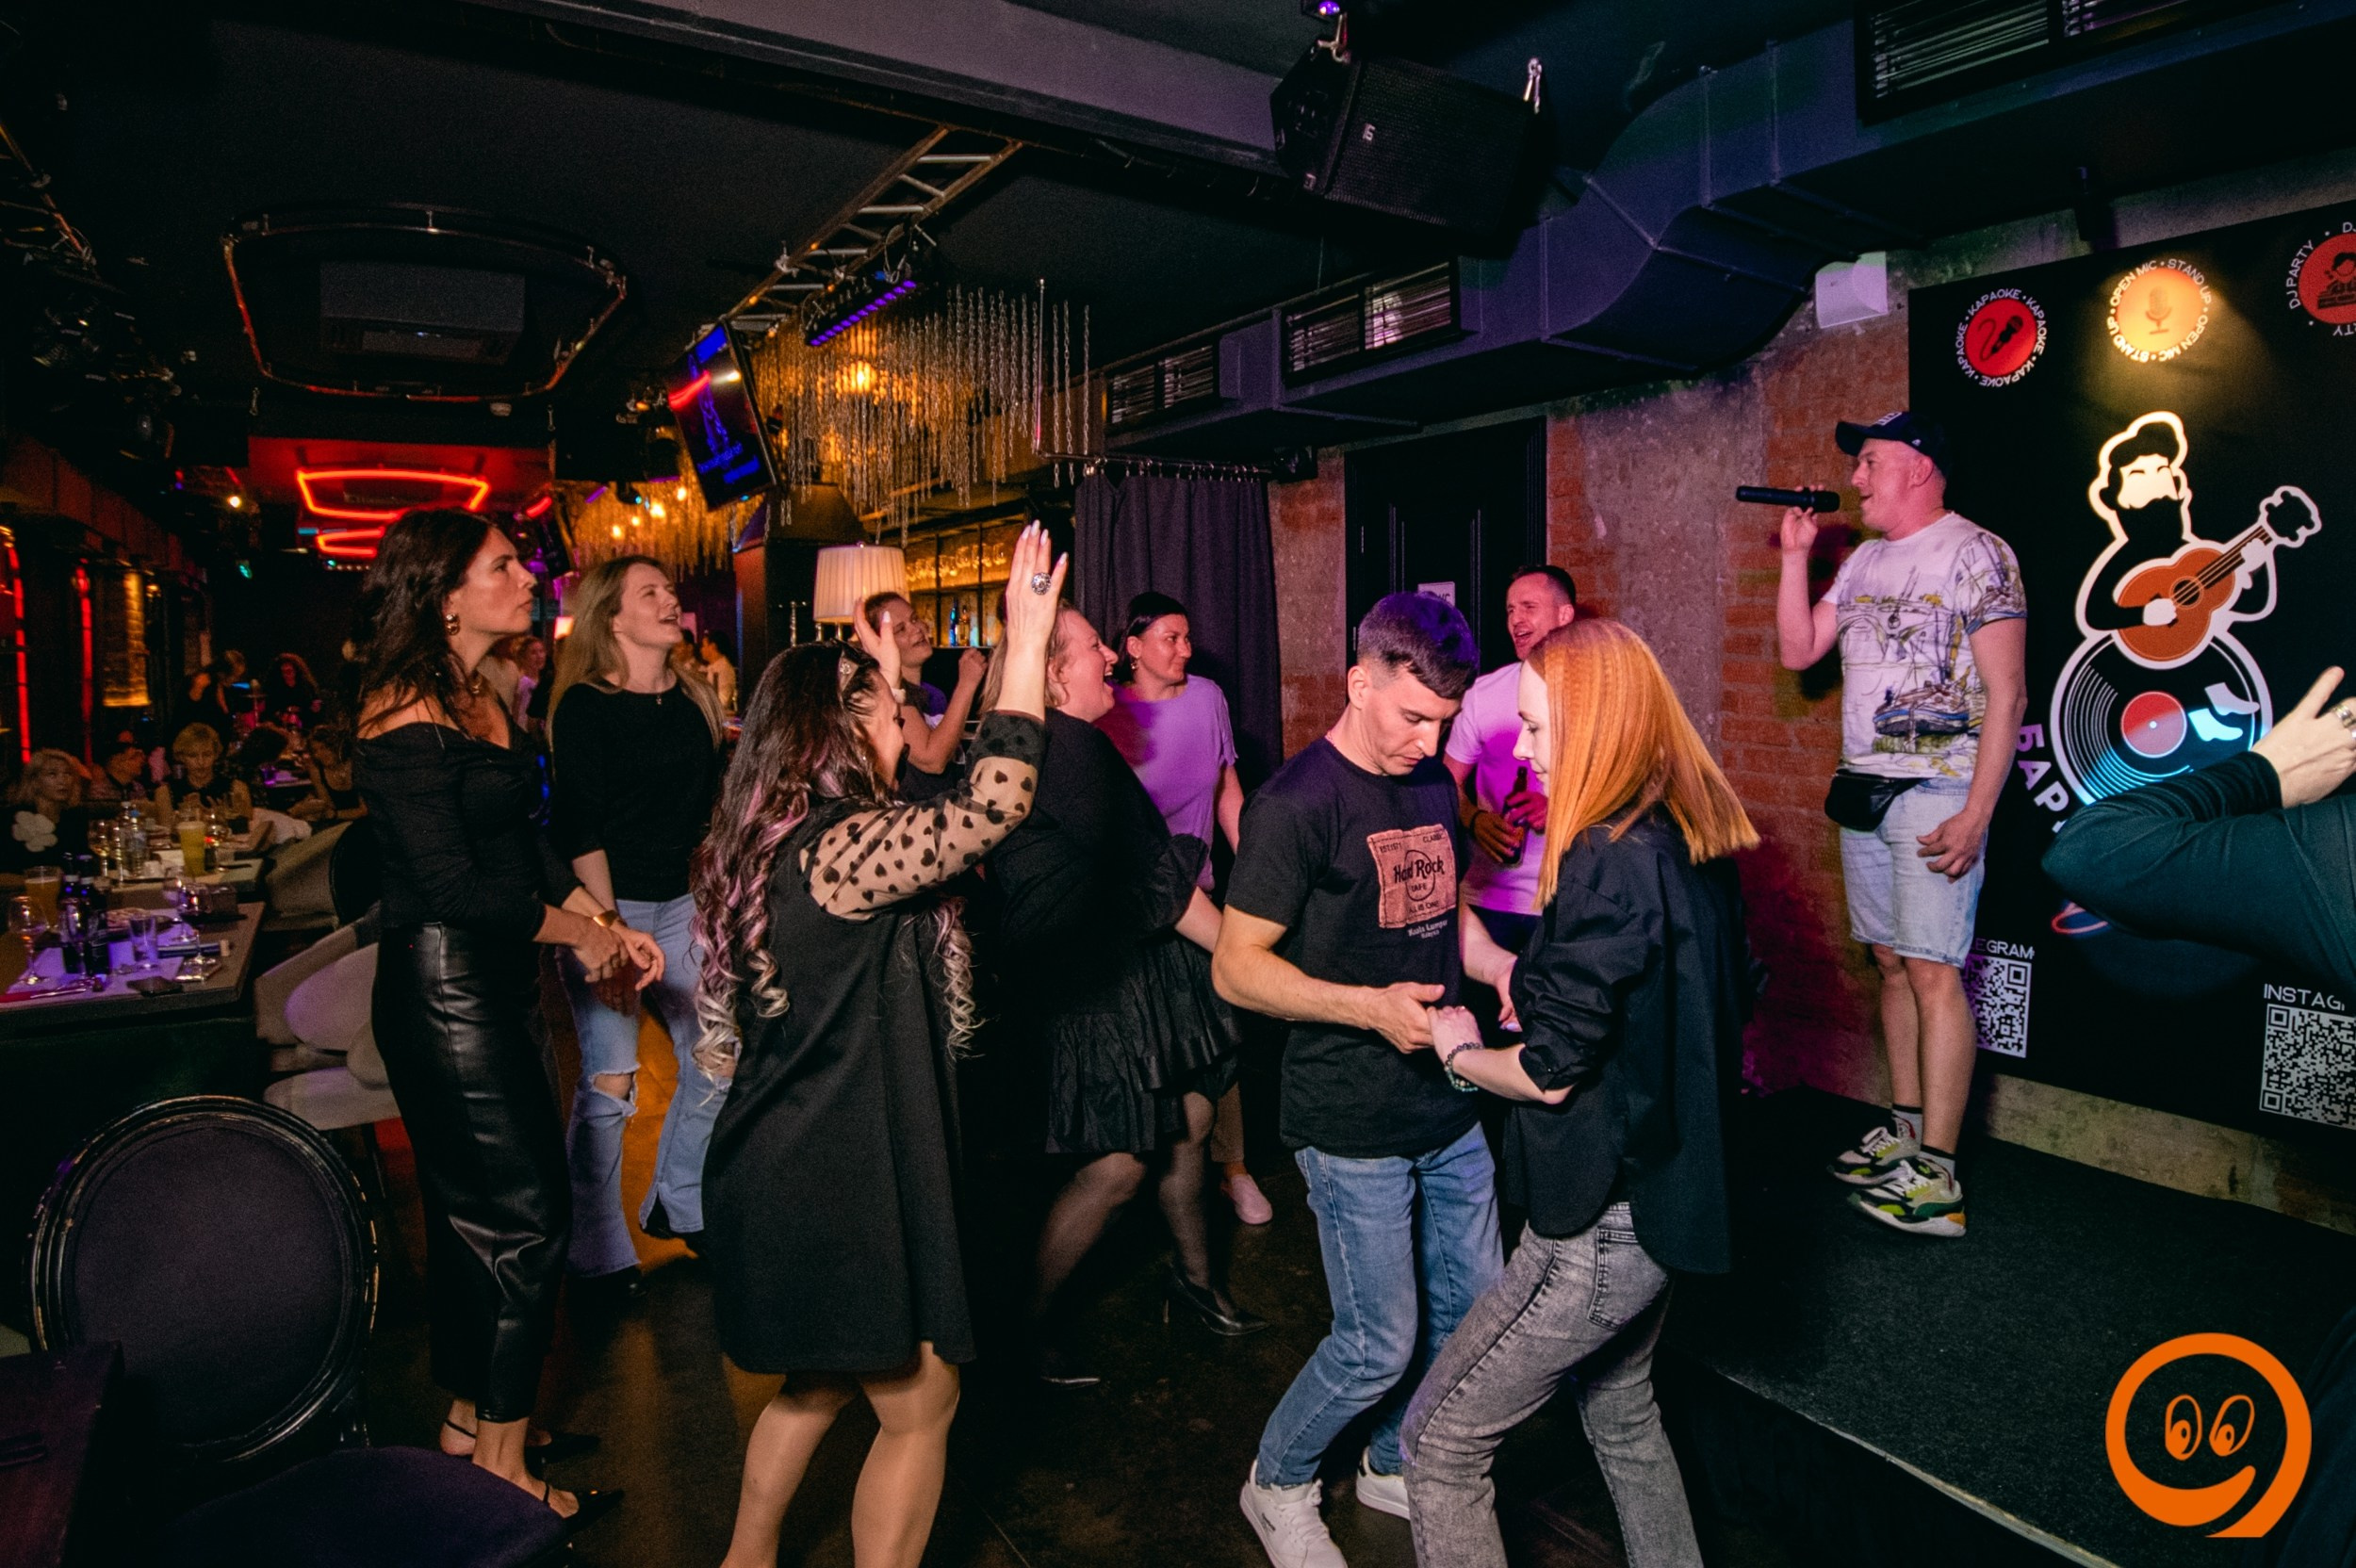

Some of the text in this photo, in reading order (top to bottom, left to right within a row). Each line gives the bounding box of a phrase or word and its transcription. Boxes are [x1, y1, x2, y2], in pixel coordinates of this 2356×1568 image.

[2110, 260, 2157, 307] OPEN MIC
[2167, 258, 2212, 304] STAND UP
[2285, 239, 2315, 310] DJ PARTY
[1968, 287, 2022, 316] КАРАОКЕ
[2180, 315, 2208, 351] OPEN
[2016, 723, 2070, 834] БАР
[1415, 855, 1445, 879] Rock
[1973, 938, 2035, 959] EGRAM
